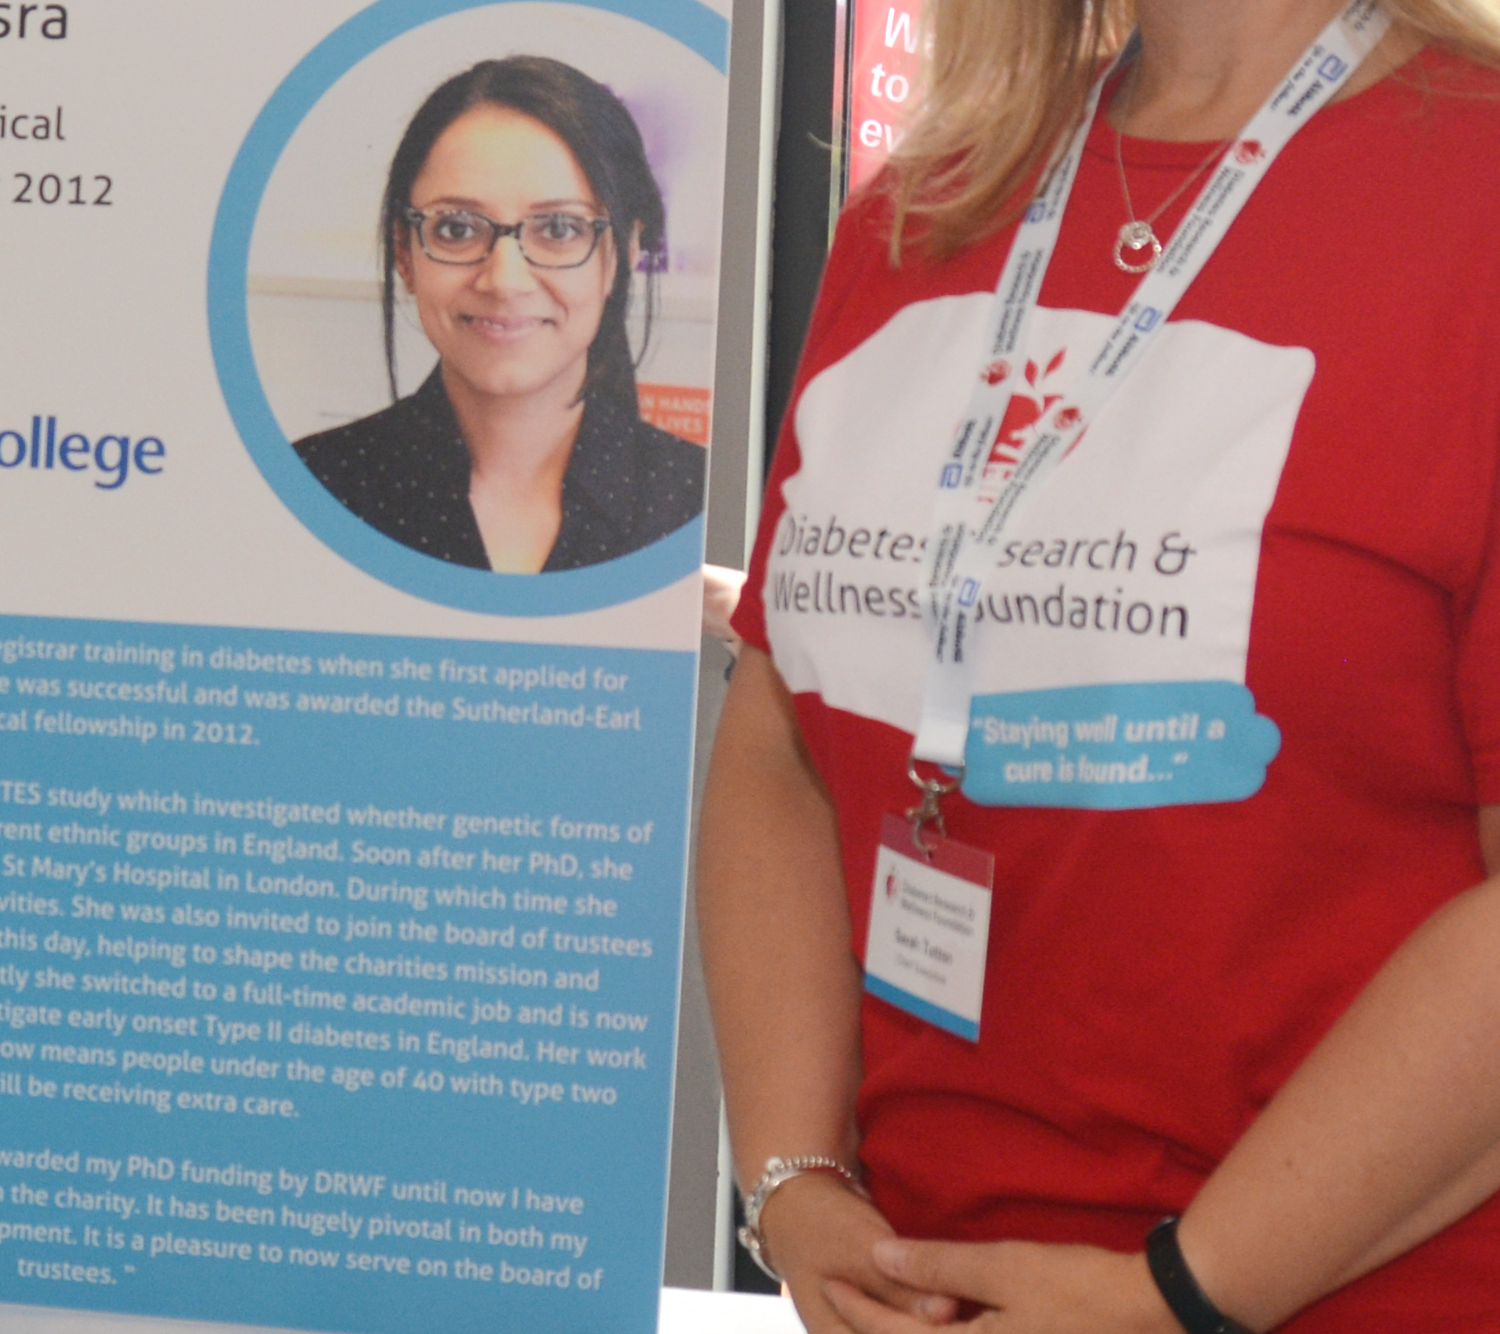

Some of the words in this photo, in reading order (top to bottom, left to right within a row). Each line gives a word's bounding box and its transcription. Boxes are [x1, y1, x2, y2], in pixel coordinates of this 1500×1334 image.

[13, 172, 112, 206] 2012
[998, 530, 1136, 571] search
[1154, 531, 1196, 575] &
[774, 571, 922, 619] Wellness
[973, 586, 1188, 638] undation
[33, 709, 158, 744] fellowship
[162, 718, 186, 741] in
[192, 720, 260, 746] 2012.
[1074, 715, 1117, 742] well
[1124, 713, 1198, 742] until
[1207, 719, 1226, 740] a
[1004, 759, 1053, 782] cure
[1058, 758, 1075, 782] is
